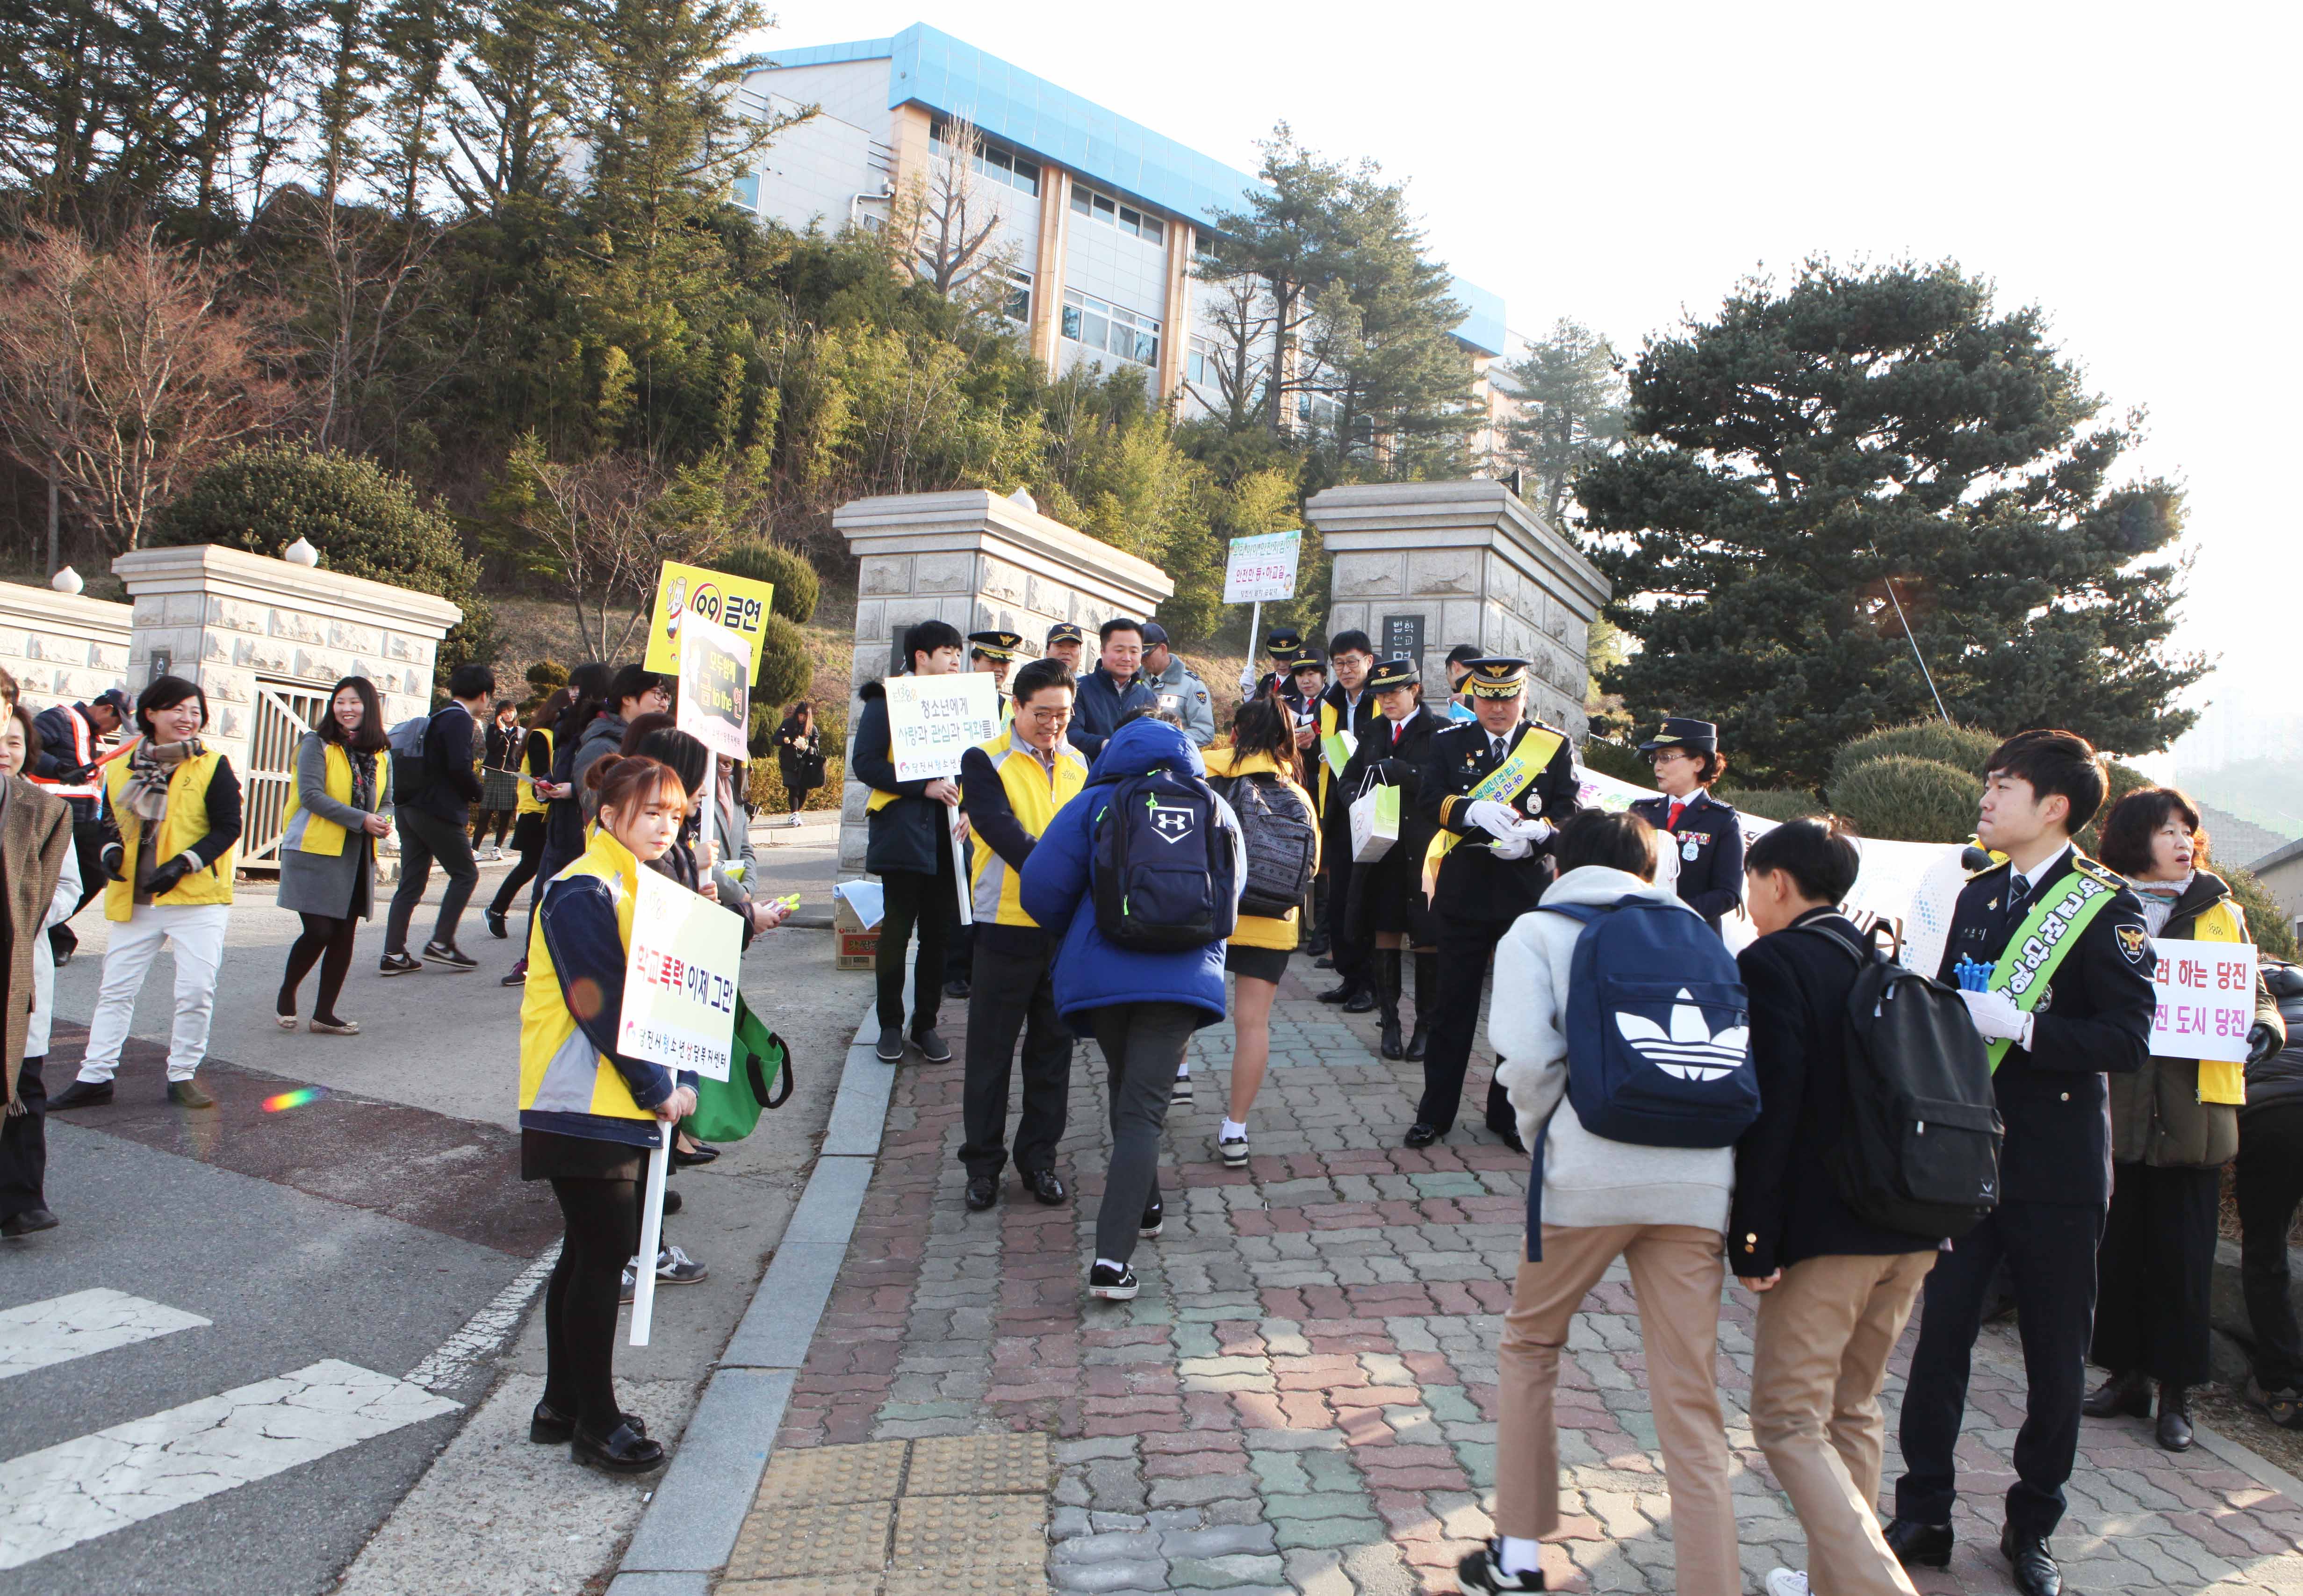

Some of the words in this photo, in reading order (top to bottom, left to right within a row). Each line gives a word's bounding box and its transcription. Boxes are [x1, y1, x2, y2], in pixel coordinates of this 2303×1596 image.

[1236, 568, 1254, 583] 안전한
[724, 596, 762, 632] 금연
[709, 651, 736, 683] 모두함께
[712, 689, 720, 707] to
[721, 691, 732, 712] the
[733, 687, 742, 720] 연
[921, 697, 969, 719] 청소년에게
[898, 725, 928, 747] 사랑과
[931, 722, 960, 743] 관심과
[963, 719, 996, 741] 대화를!
[637, 944, 684, 996] 학교폭력
[688, 965, 710, 1005] 이제
[711, 975, 733, 1014] 그만
[2179, 960, 2208, 988] 하는
[2217, 962, 2246, 990] 당진
[2176, 1006, 2206, 1035] 도시
[2215, 1008, 2245, 1037] 당진
